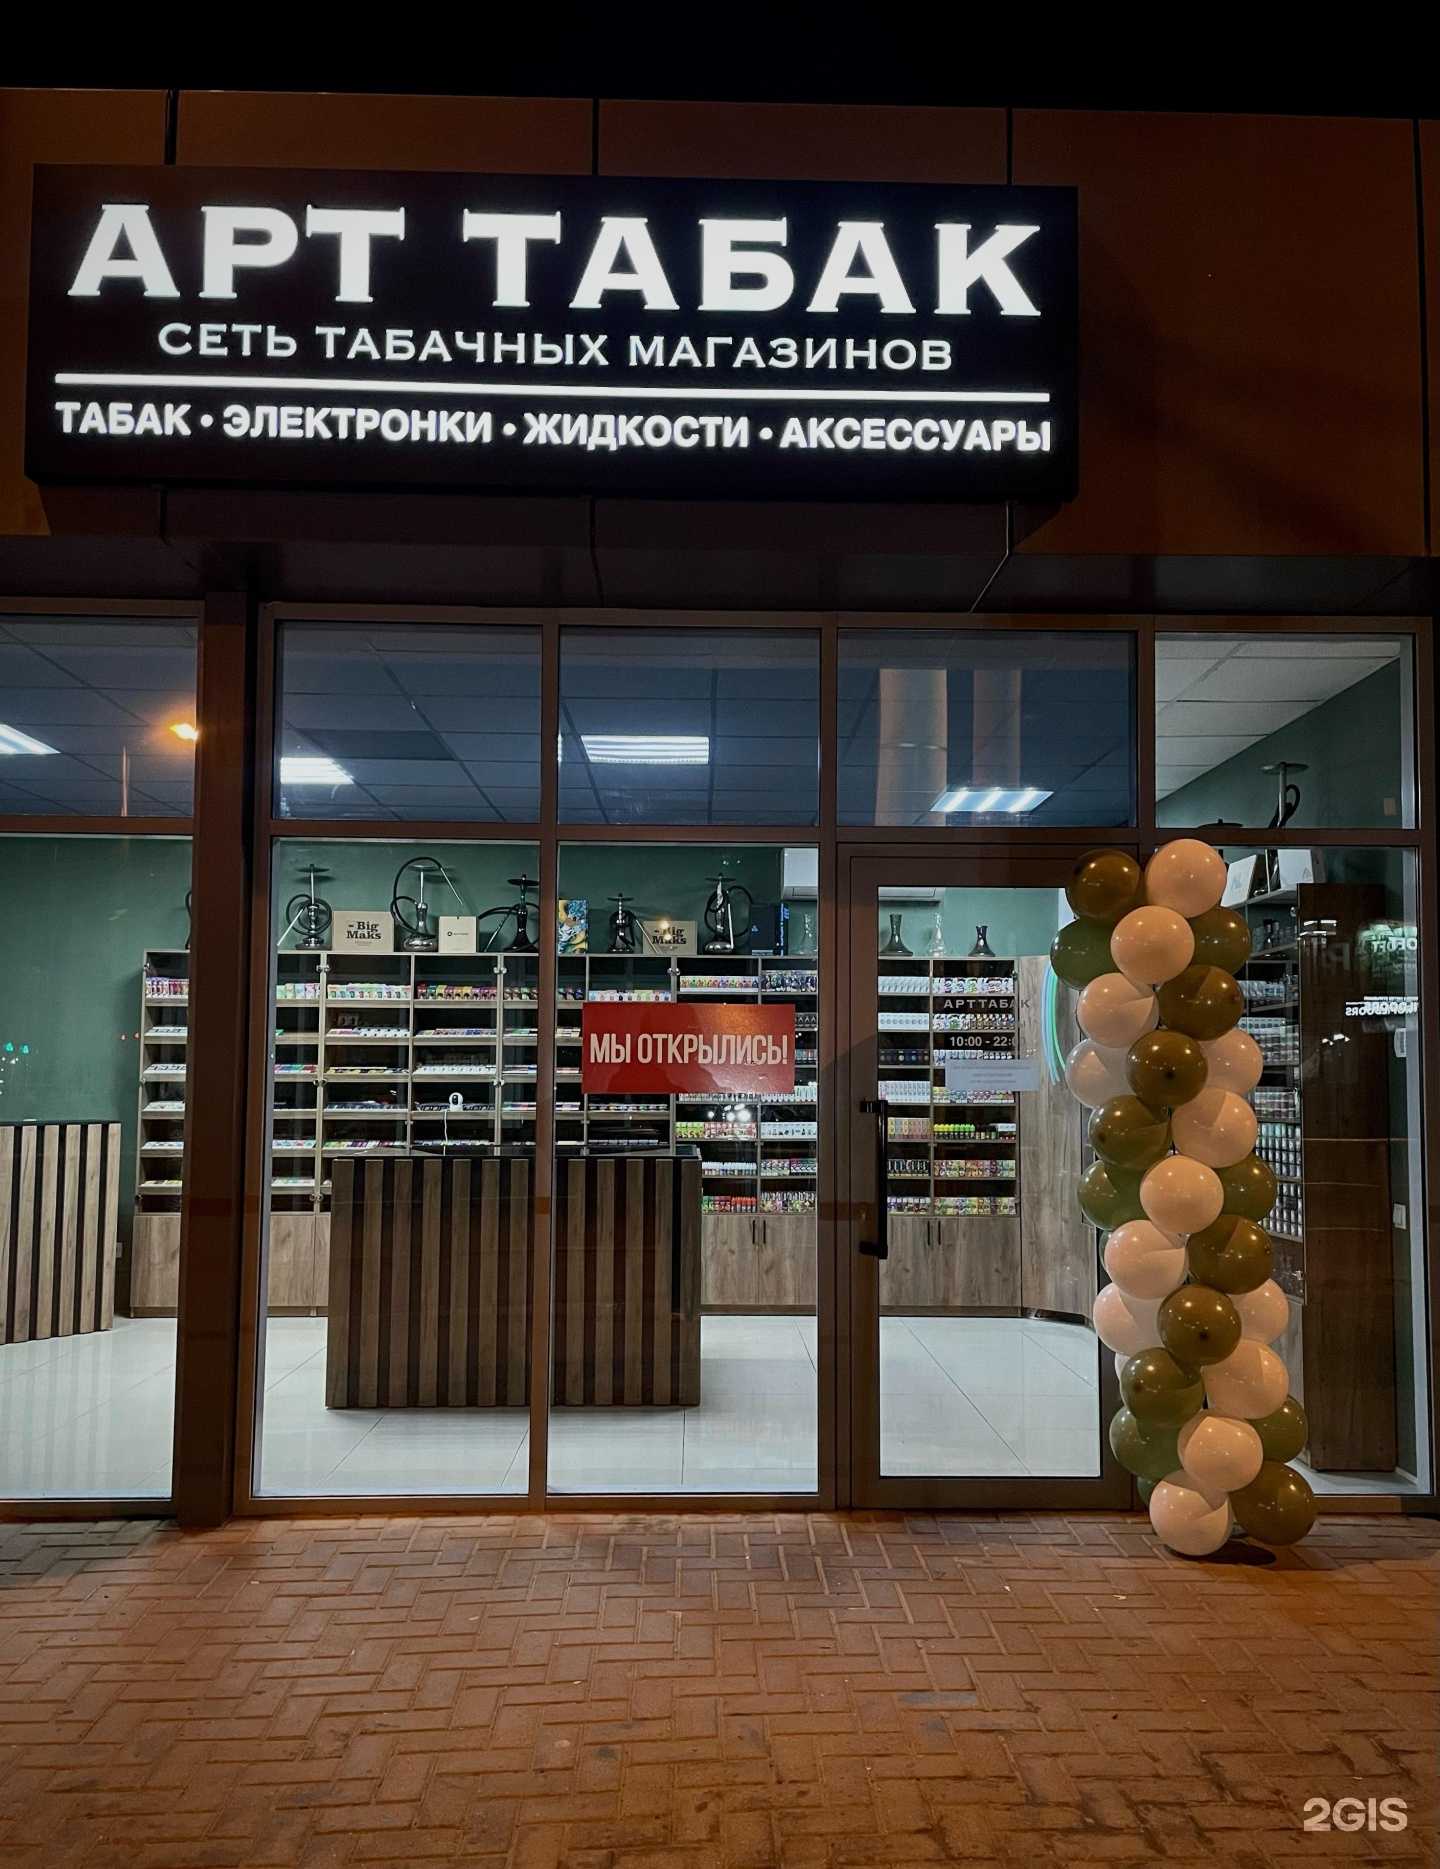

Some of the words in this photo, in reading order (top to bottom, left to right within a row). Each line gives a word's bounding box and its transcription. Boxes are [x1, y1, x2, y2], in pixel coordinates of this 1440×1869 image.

[68, 204, 405, 303] АРТ
[463, 209, 1042, 316] ТАБАК
[158, 322, 297, 357] СЕТЬ
[315, 326, 609, 366] ТАБАЧНЫХ
[629, 335, 952, 371] МАГАЗИНОВ
[55, 401, 192, 436] ТАБАК
[222, 404, 493, 443] ЭЛЕКТРОНКИ
[522, 412, 749, 453] ЖИДКОСТИ
[779, 417, 1051, 455] АКСЕССУАРЫ
[346, 930, 381, 940] Maks
[357, 921, 379, 932] Big
[589, 1033, 631, 1064] МЫ
[637, 1034, 788, 1065] ОТКРЫЛИСЬ!
[950, 1036, 982, 1047] 10:00
